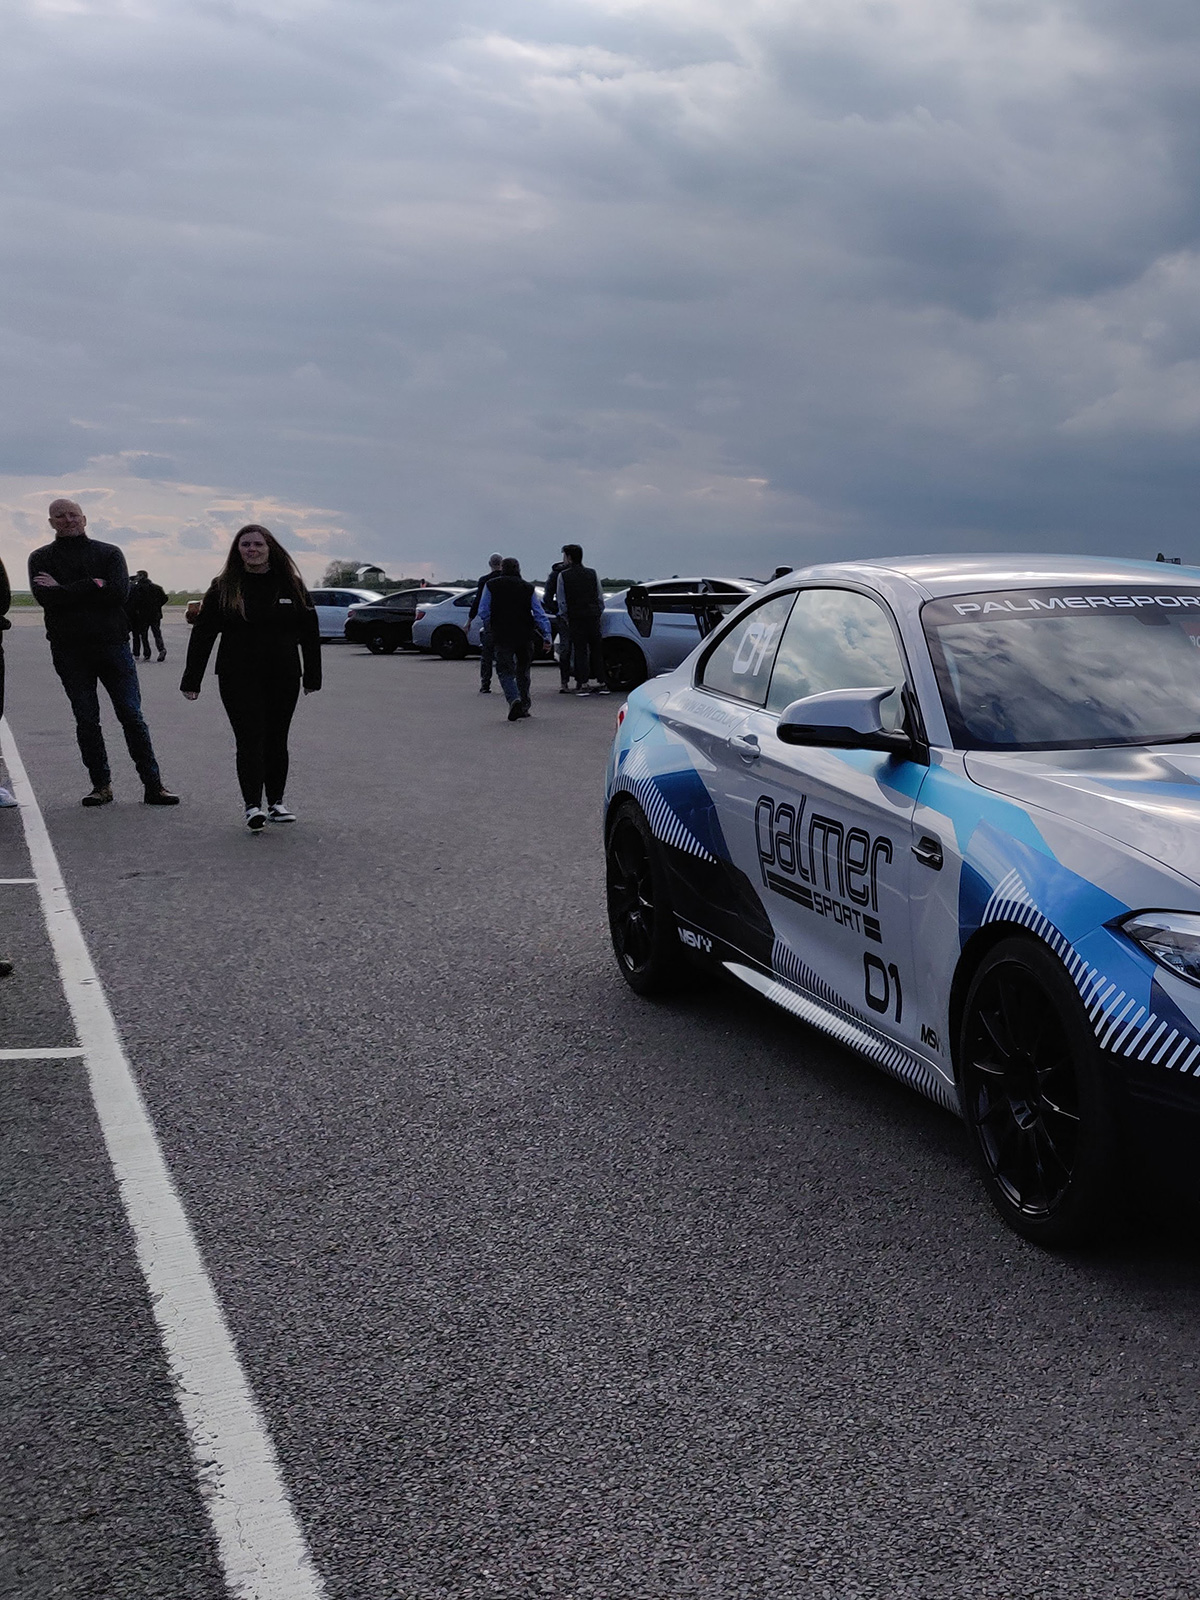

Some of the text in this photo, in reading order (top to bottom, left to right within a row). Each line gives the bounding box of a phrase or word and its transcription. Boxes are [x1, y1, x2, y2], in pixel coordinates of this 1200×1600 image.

[732, 622, 778, 677] 01
[755, 794, 893, 913] palmer
[812, 892, 862, 934] SPORT
[863, 951, 903, 1024] 01
